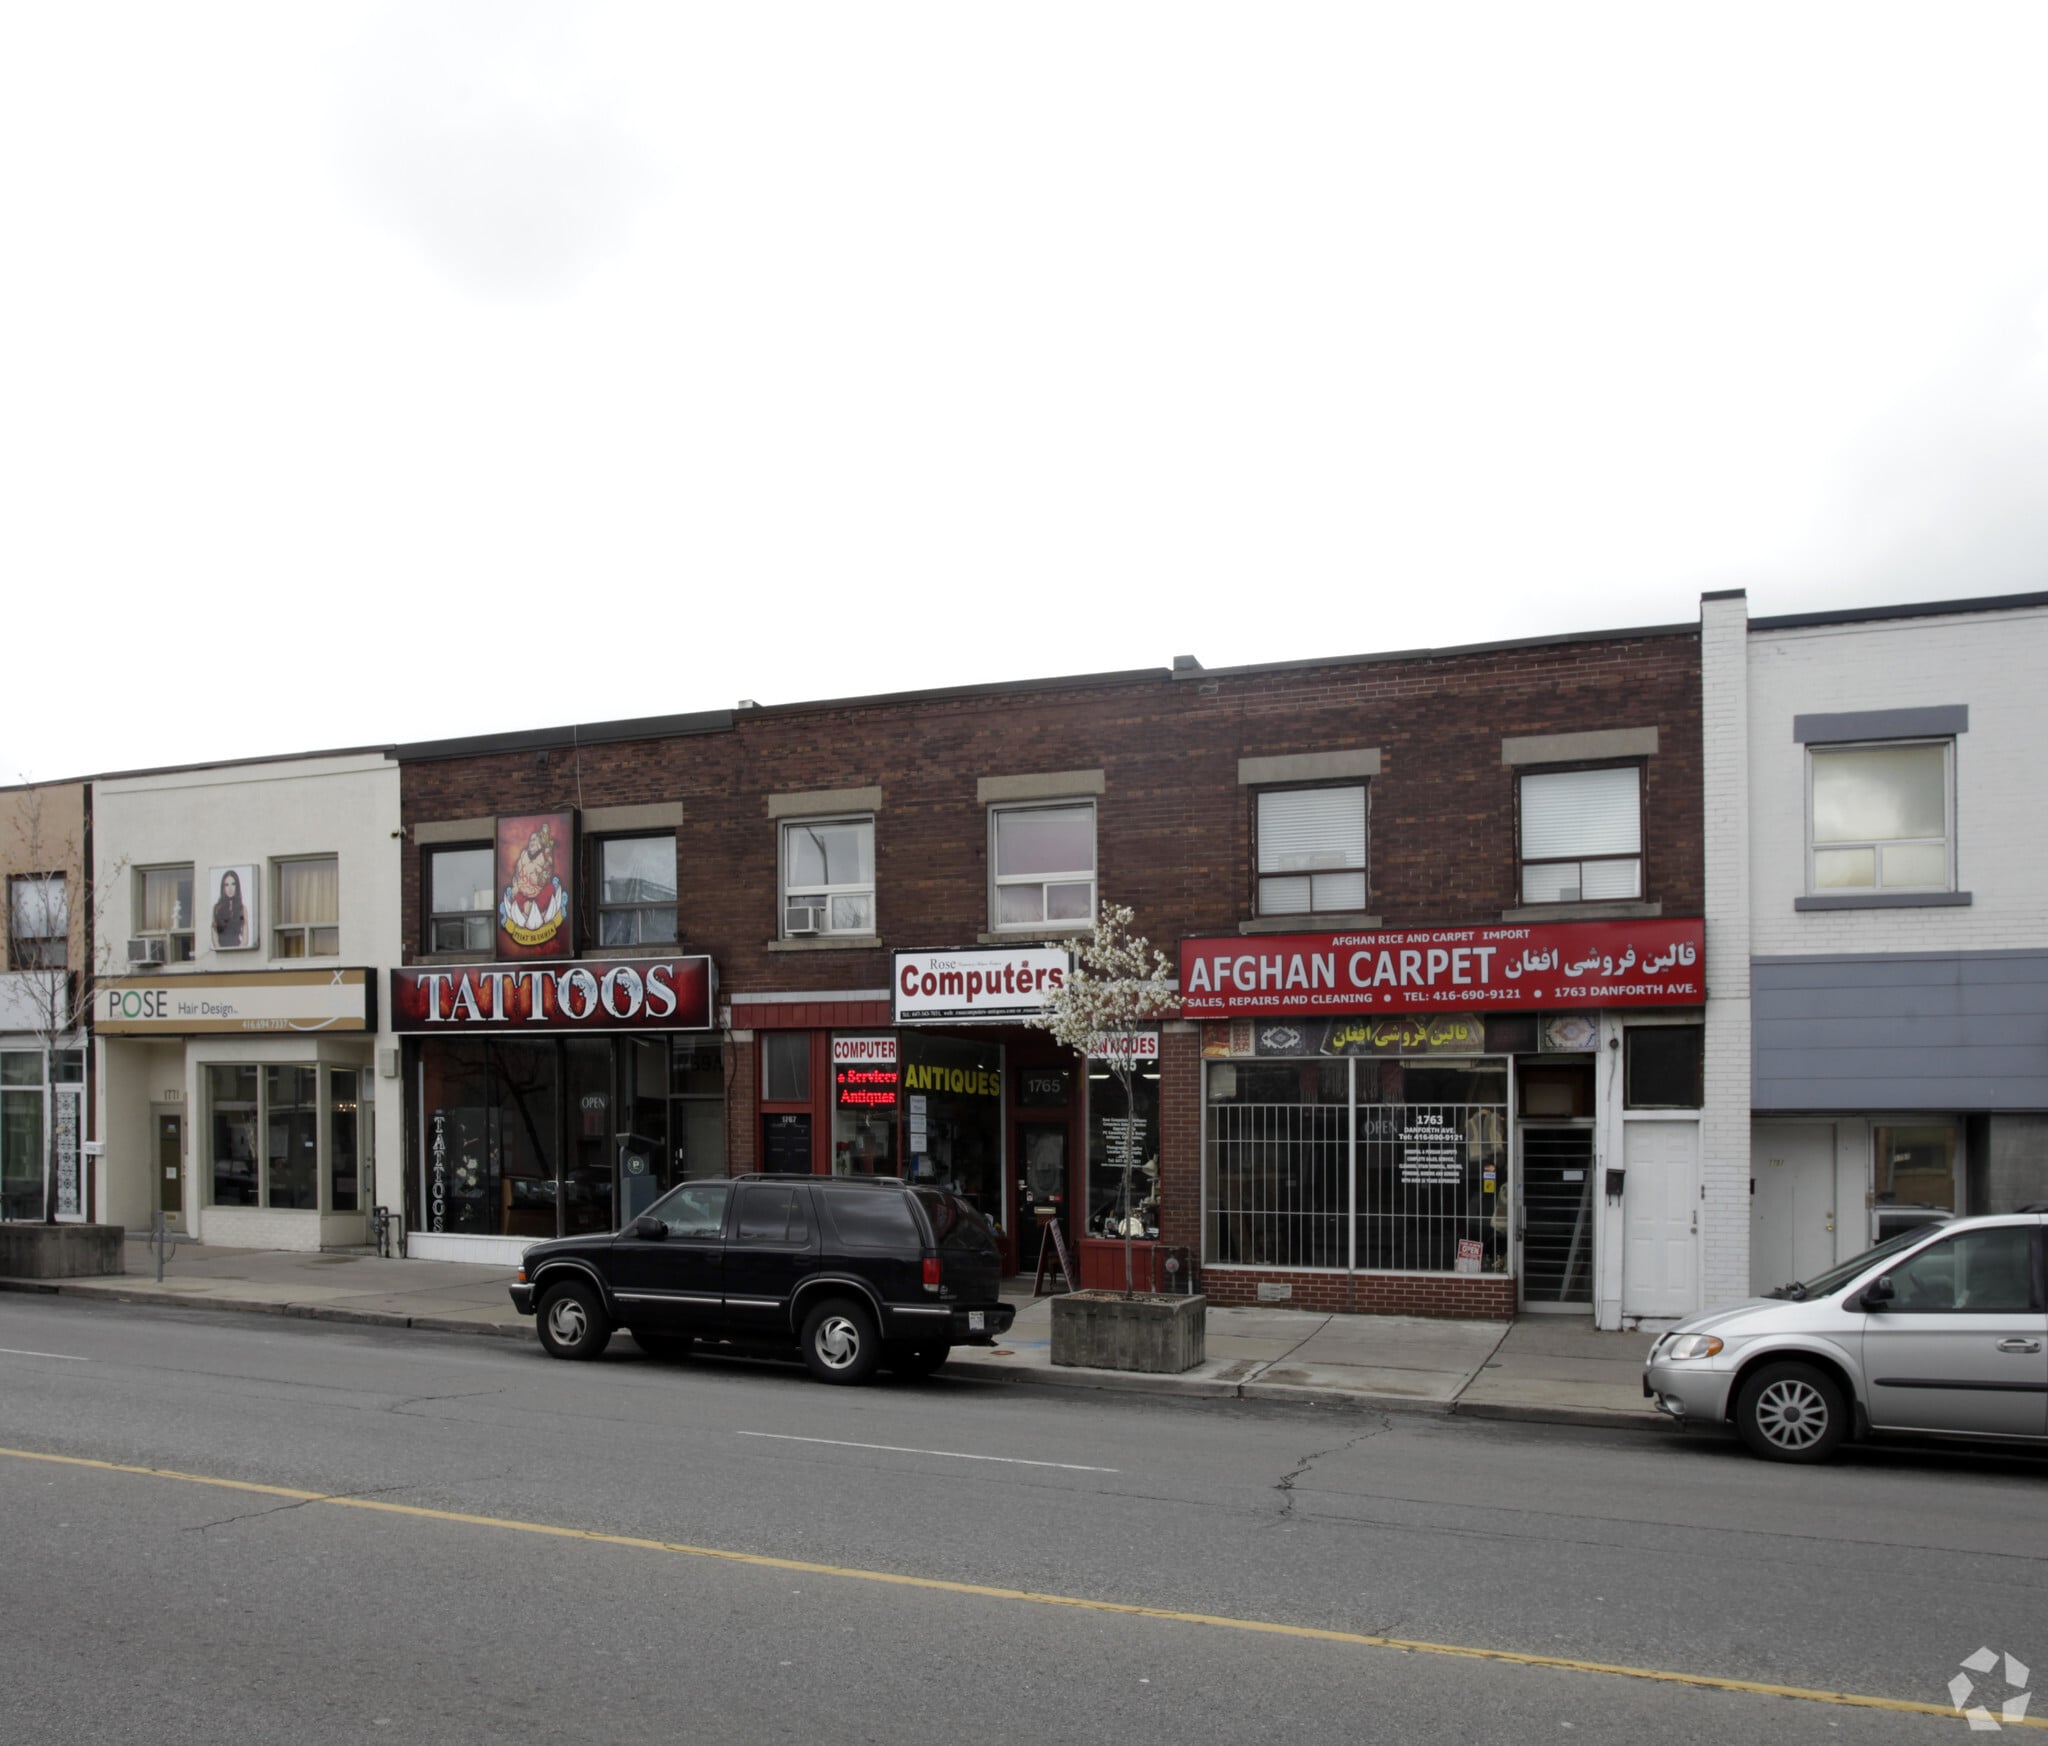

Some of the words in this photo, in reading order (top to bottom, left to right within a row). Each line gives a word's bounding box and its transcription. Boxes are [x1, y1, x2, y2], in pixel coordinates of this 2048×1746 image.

[1331, 935, 1376, 947] AFGHAN
[1378, 934, 1403, 945] RICE
[1406, 933, 1430, 944] AND
[1432, 931, 1475, 944] CARPET
[1482, 929, 1531, 941] IMPORT
[929, 958, 957, 970] Rose
[1188, 952, 1336, 993] AFGHAN
[1347, 946, 1497, 988] CARPET
[900, 960, 1064, 1004] Computers
[416, 963, 678, 1022] TATTOOS
[1187, 996, 1226, 1009] SALES,
[1228, 995, 1280, 1007] REPAIRS
[1282, 994, 1308, 1006] AND
[1310, 993, 1373, 1005] CLEANING
[1403, 991, 1430, 1002] TEL:
[1432, 988, 1522, 1001] 416-690-9121
[1554, 987, 1587, 998] 1763
[1589, 984, 1664, 997] DANFORTH
[1666, 982, 1698, 995] AVE.
[108, 990, 168, 1018] POSE
[178, 1002, 199, 1014] Hair
[201, 1001, 234, 1017] Design
[834, 1041, 896, 1059] COMPUTER
[847, 1069, 898, 1084] Services
[905, 1063, 1001, 1097] ANTIQUES
[1028, 1079, 1061, 1093] 1765
[582, 1096, 607, 1109] OPEN
[840, 1089, 896, 1107] Antiques
[1365, 1119, 1398, 1135] OPEN
[1416, 1115, 1444, 1125] 1763
[432, 1116, 446, 1234] TATTOOS
